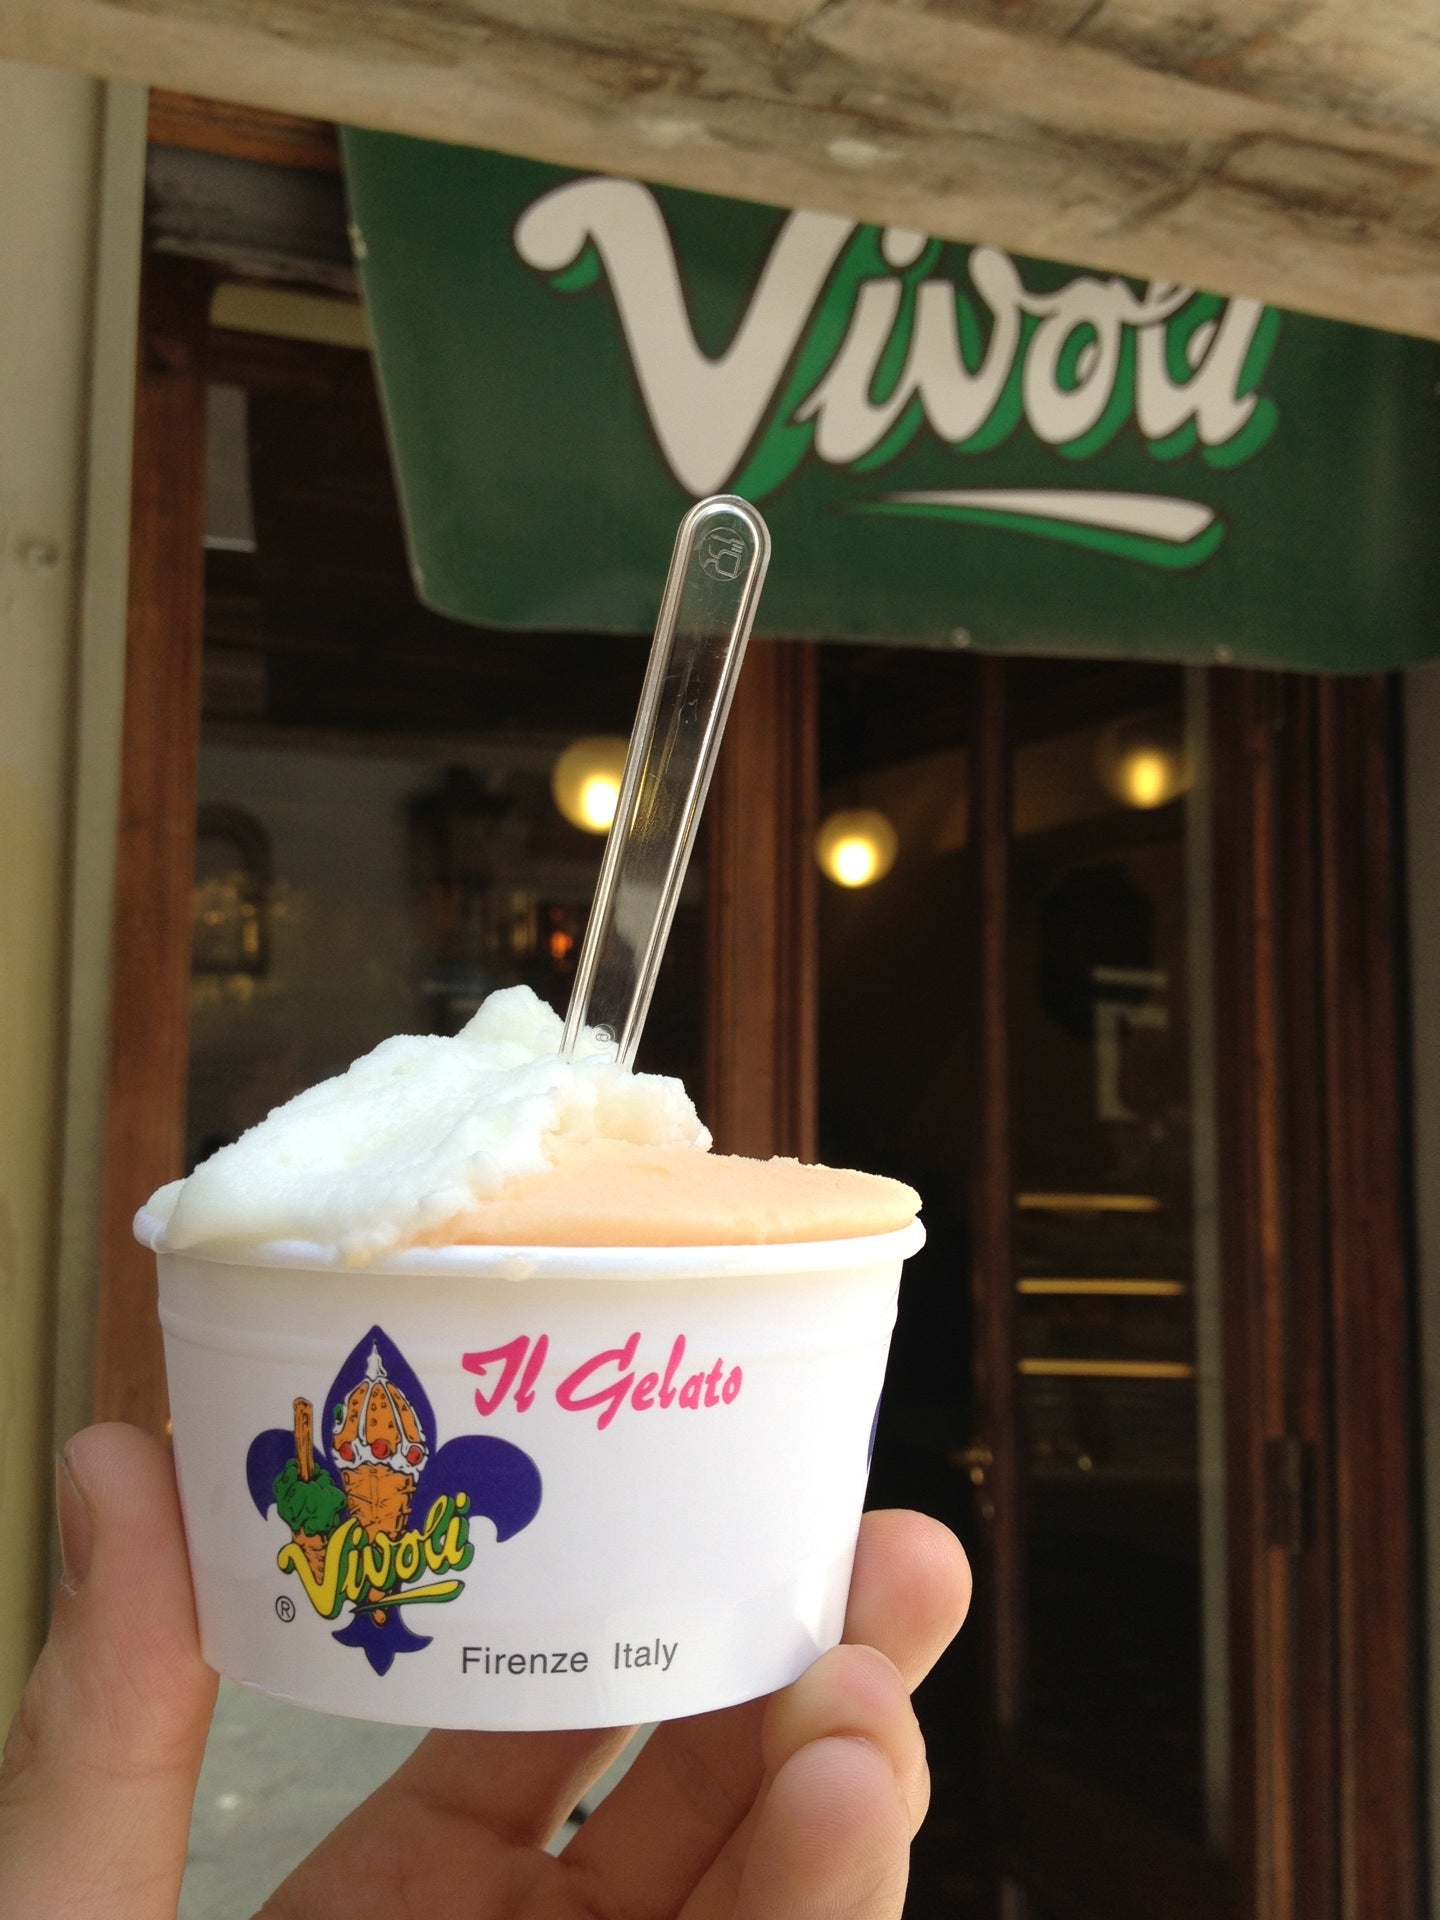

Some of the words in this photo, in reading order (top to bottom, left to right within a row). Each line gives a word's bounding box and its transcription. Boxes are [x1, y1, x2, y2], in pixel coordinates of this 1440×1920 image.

[462, 1334, 548, 1416] Il
[556, 1332, 743, 1430] Gelato
[277, 1492, 475, 1619] Vivoli
[461, 1646, 589, 1675] Firenze
[613, 1638, 678, 1671] Italy
